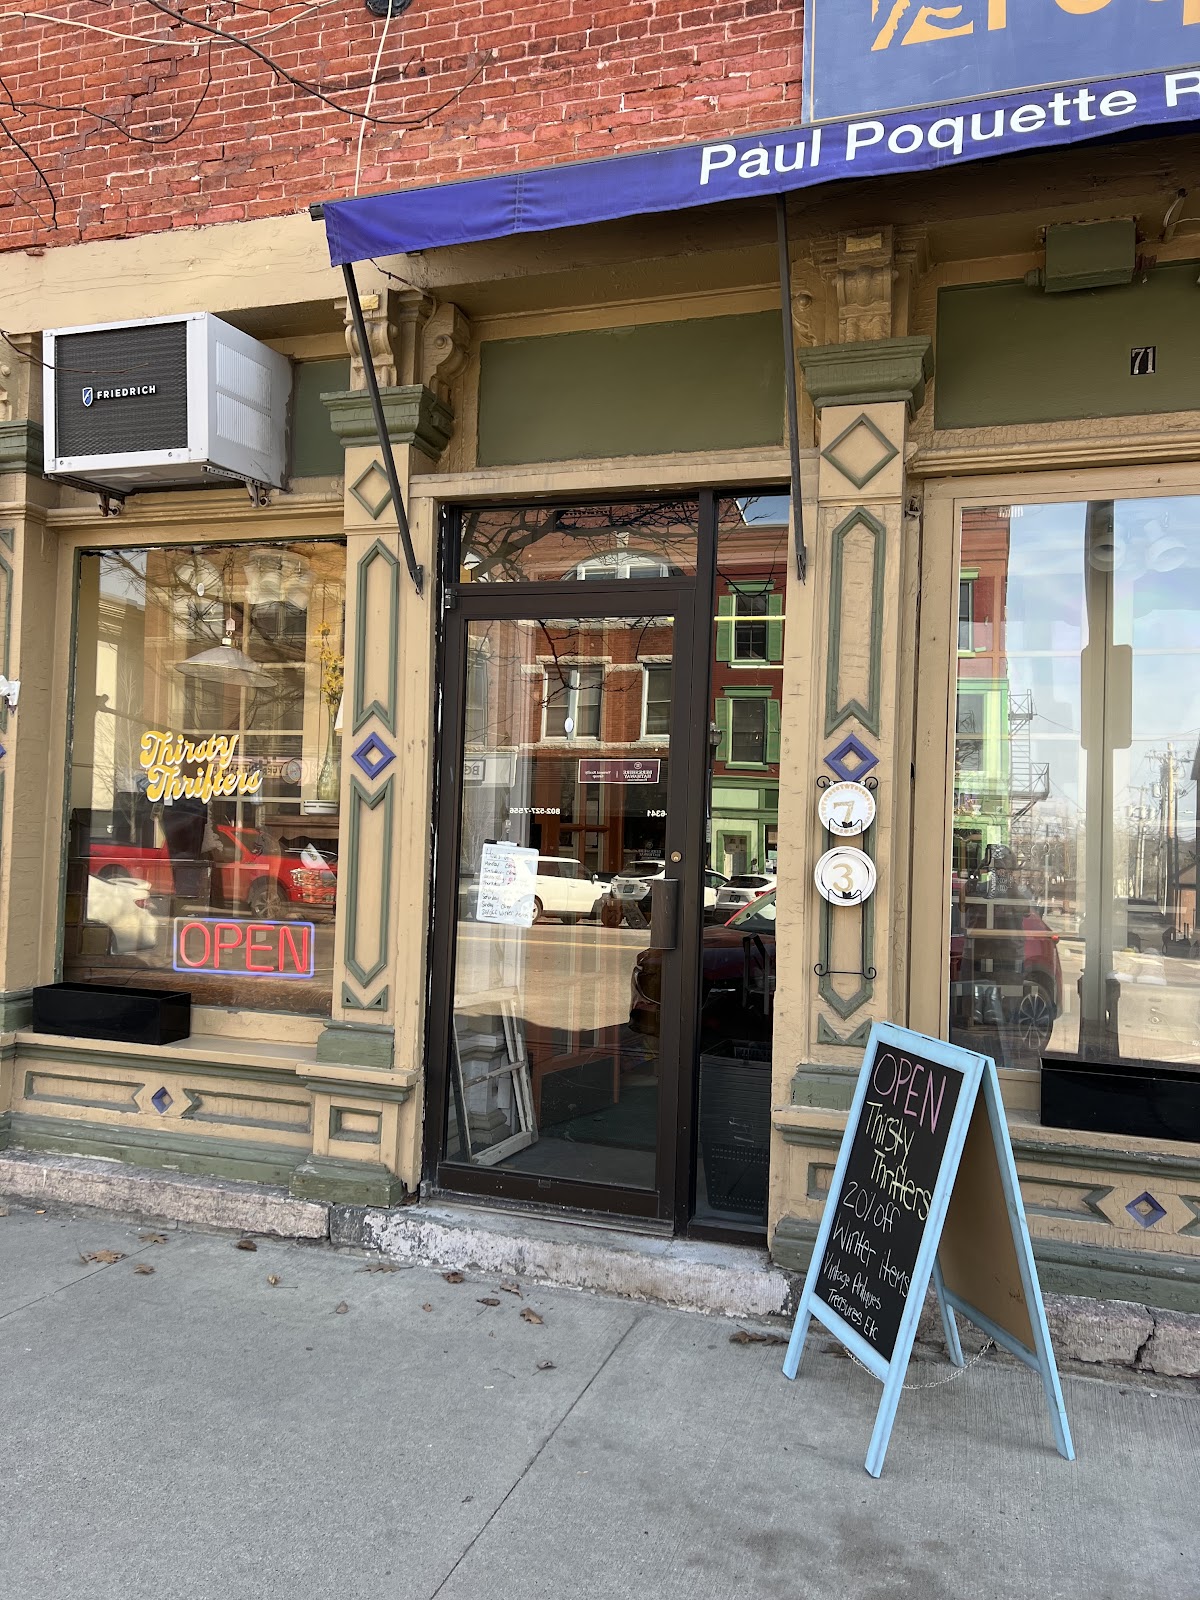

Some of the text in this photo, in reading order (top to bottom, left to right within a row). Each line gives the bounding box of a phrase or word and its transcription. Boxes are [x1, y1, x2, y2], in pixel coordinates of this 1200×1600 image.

[700, 128, 822, 186] Paul
[846, 88, 1138, 162] Poquette
[1131, 347, 1155, 375] 71
[97, 385, 156, 400] FRIEDRICH
[140, 730, 239, 769] Thirsty
[147, 763, 263, 804] Thrifters
[833, 800, 855, 822] 7
[832, 863, 854, 892] 3
[179, 922, 308, 973] OPEN
[873, 1053, 947, 1135] OPEN
[866, 1101, 915, 1167] Thirsty
[871, 1148, 932, 1221] Thrifters
[833, 1212, 877, 1268] Winter
